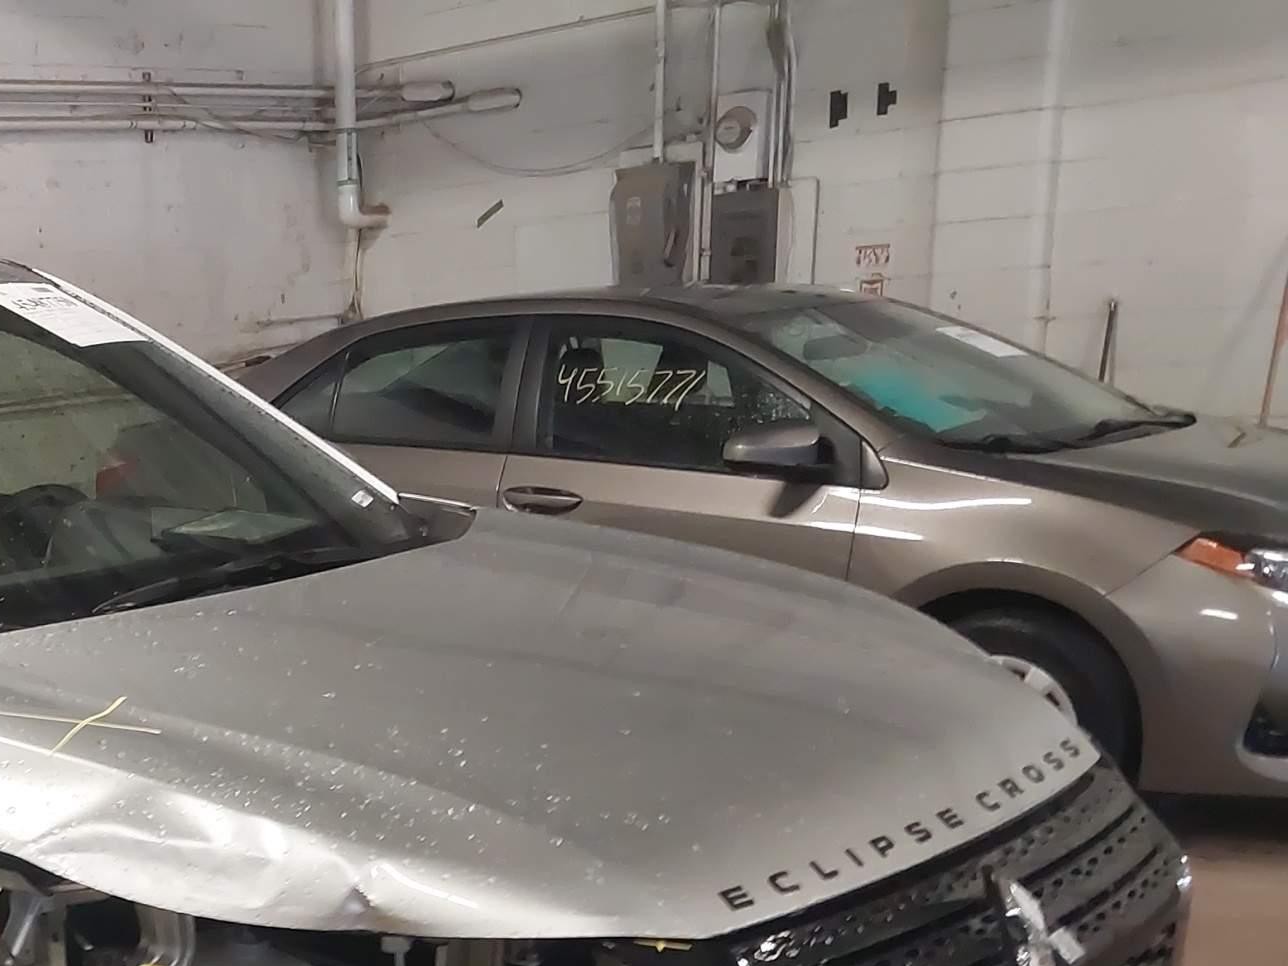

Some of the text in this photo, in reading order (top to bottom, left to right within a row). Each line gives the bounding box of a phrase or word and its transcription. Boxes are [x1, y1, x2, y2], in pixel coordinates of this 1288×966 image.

[557, 363, 707, 412] 45515771
[717, 738, 1081, 912] ECLIPSE CROSS
